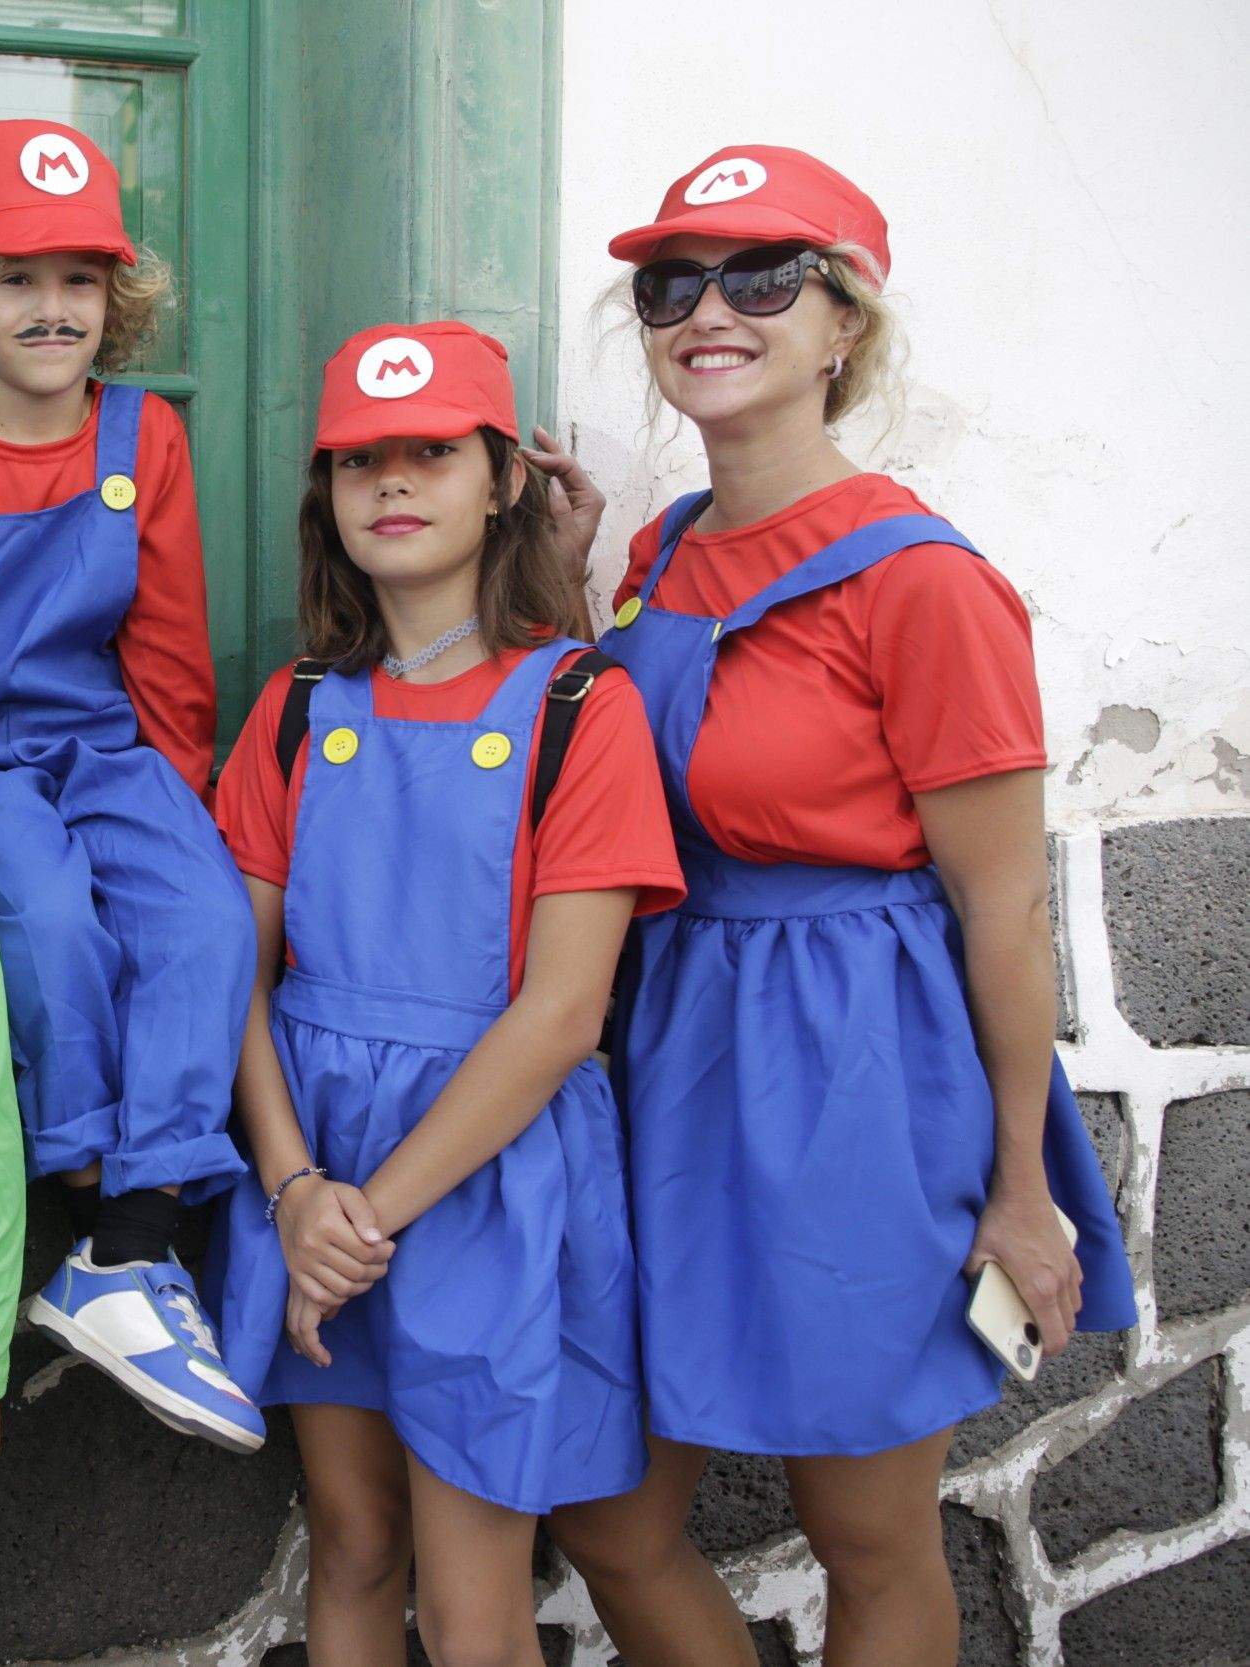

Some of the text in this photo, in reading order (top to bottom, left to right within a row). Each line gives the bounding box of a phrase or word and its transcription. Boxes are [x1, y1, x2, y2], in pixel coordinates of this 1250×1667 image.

[36, 151, 79, 181] M
[700, 169, 748, 194] M
[376, 355, 421, 381] M
